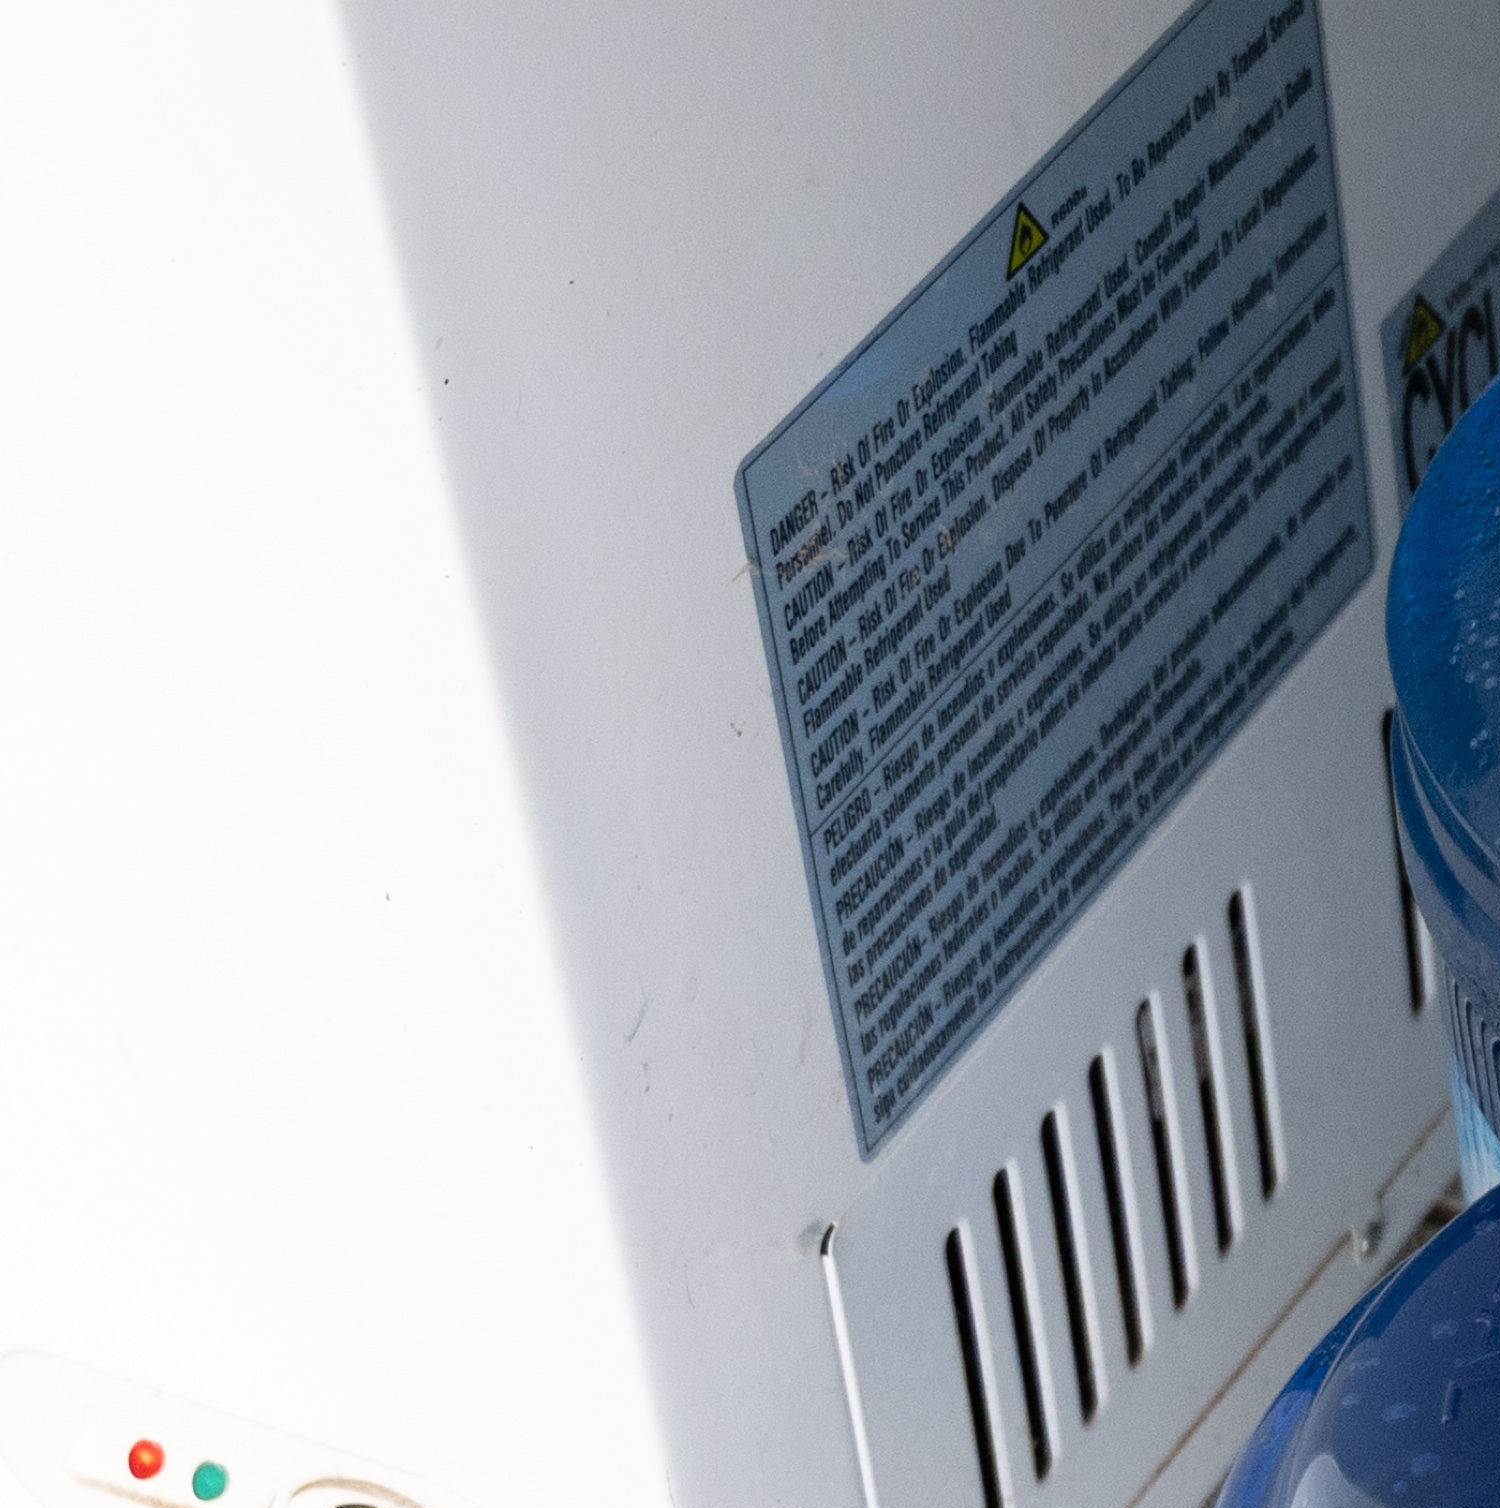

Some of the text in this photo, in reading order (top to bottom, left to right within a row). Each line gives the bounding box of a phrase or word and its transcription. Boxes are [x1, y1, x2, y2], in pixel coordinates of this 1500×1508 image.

[769, 490, 818, 556] DANGER
[830, 453, 856, 495] Risk
[857, 435, 871, 467] Of
[872, 418, 895, 452] Fire
[896, 399, 910, 427] Or
[911, 348, 967, 412] Explosion.
[968, 282, 1026, 353] Flammable
[1027, 218, 1084, 292] Refrigerant
[1085, 189, 1114, 232] Used.
[1116, 173, 1130, 200] To
[1131, 159, 1146, 185] Be
[775, 331, 1018, 590] Personnel. Do Not Puncture Refrigerant Tubing
[784, 562, 834, 631] CAUTION
[847, 526, 873, 566] Risk
[875, 506, 888, 537] Of
[890, 488, 912, 521] Fire
[915, 470, 928, 496] Or
[931, 416, 984, 480] Explosion.
[989, 350, 1043, 420] Flammable
[1046, 285, 1101, 358] Refrigerant
[1104, 255, 1132, 298] Used.
[789, 616, 827, 664] Before
[828, 555, 886, 626] Attempting
[885, 538, 901, 563] To
[901, 497, 941, 549] Service
[941, 471, 965, 505] This
[965, 425, 1008, 482] Product.
[1011, 402, 1025, 436] All
[1025, 374, 1057, 418] Safety
[1058, 313, 1116, 383] Precautions
[1117, 282, 1141, 322] Must
[1142, 271, 1155, 295] be
[797, 637, 847, 705] CAUTION
[858, 602, 883, 641] Risk
[884, 583, 897, 614] Of
[898, 565, 921, 599] Fire
[922, 548, 934, 574] Or
[937, 495, 990, 559] Explosion.
[992, 447, 1033, 501] Dispose
[1034, 426, 1046, 456] Of
[1091, 373, 1102, 396] In
[1104, 313, 1158, 383] Accordance
[810, 710, 859, 778] CAUTION
[872, 673, 896, 712] Risk
[899, 653, 912, 683] Of
[914, 634, 935, 667] Fire
[938, 616, 951, 641] Or
[953, 562, 1003, 625] Explosion
[1005, 537, 1026, 570] Due
[1027, 519, 1042, 544] To
[1043, 471, 1087, 527] Puncture
[1090, 448, 1102, 478] Of
[1104, 390, 1158, 463] Refrigerant
[803, 566, 950, 738] Flammable Refrigerant Used
[816, 584, 1011, 810] Carefully. Flammable Refrigerant Used
[823, 788, 871, 853] PELIGRO
[882, 742, 919, 790] Riesgo
[882, 760, 936, 828] solamente
[835, 836, 904, 924] PRECAUCIÓN
[842, 931, 856, 956] de
[857, 857, 923, 939] reparaciones
[847, 959, 865, 987] las
[866, 884, 933, 973] precauciones
[934, 867, 947, 892] de
[854, 935, 927, 1022] PRECAUCIÓN–
[928, 893, 964, 941] Riesgo
[860, 1027, 878, 1055] las
[878, 954, 942, 1035] regulaciones
[867, 1003, 934, 1092] PRECAUCIÓN
[942, 958, 978, 1006] Riesgo
[873, 1088, 896, 1122] siga
[897, 996, 976, 1096] cuidadosamente
